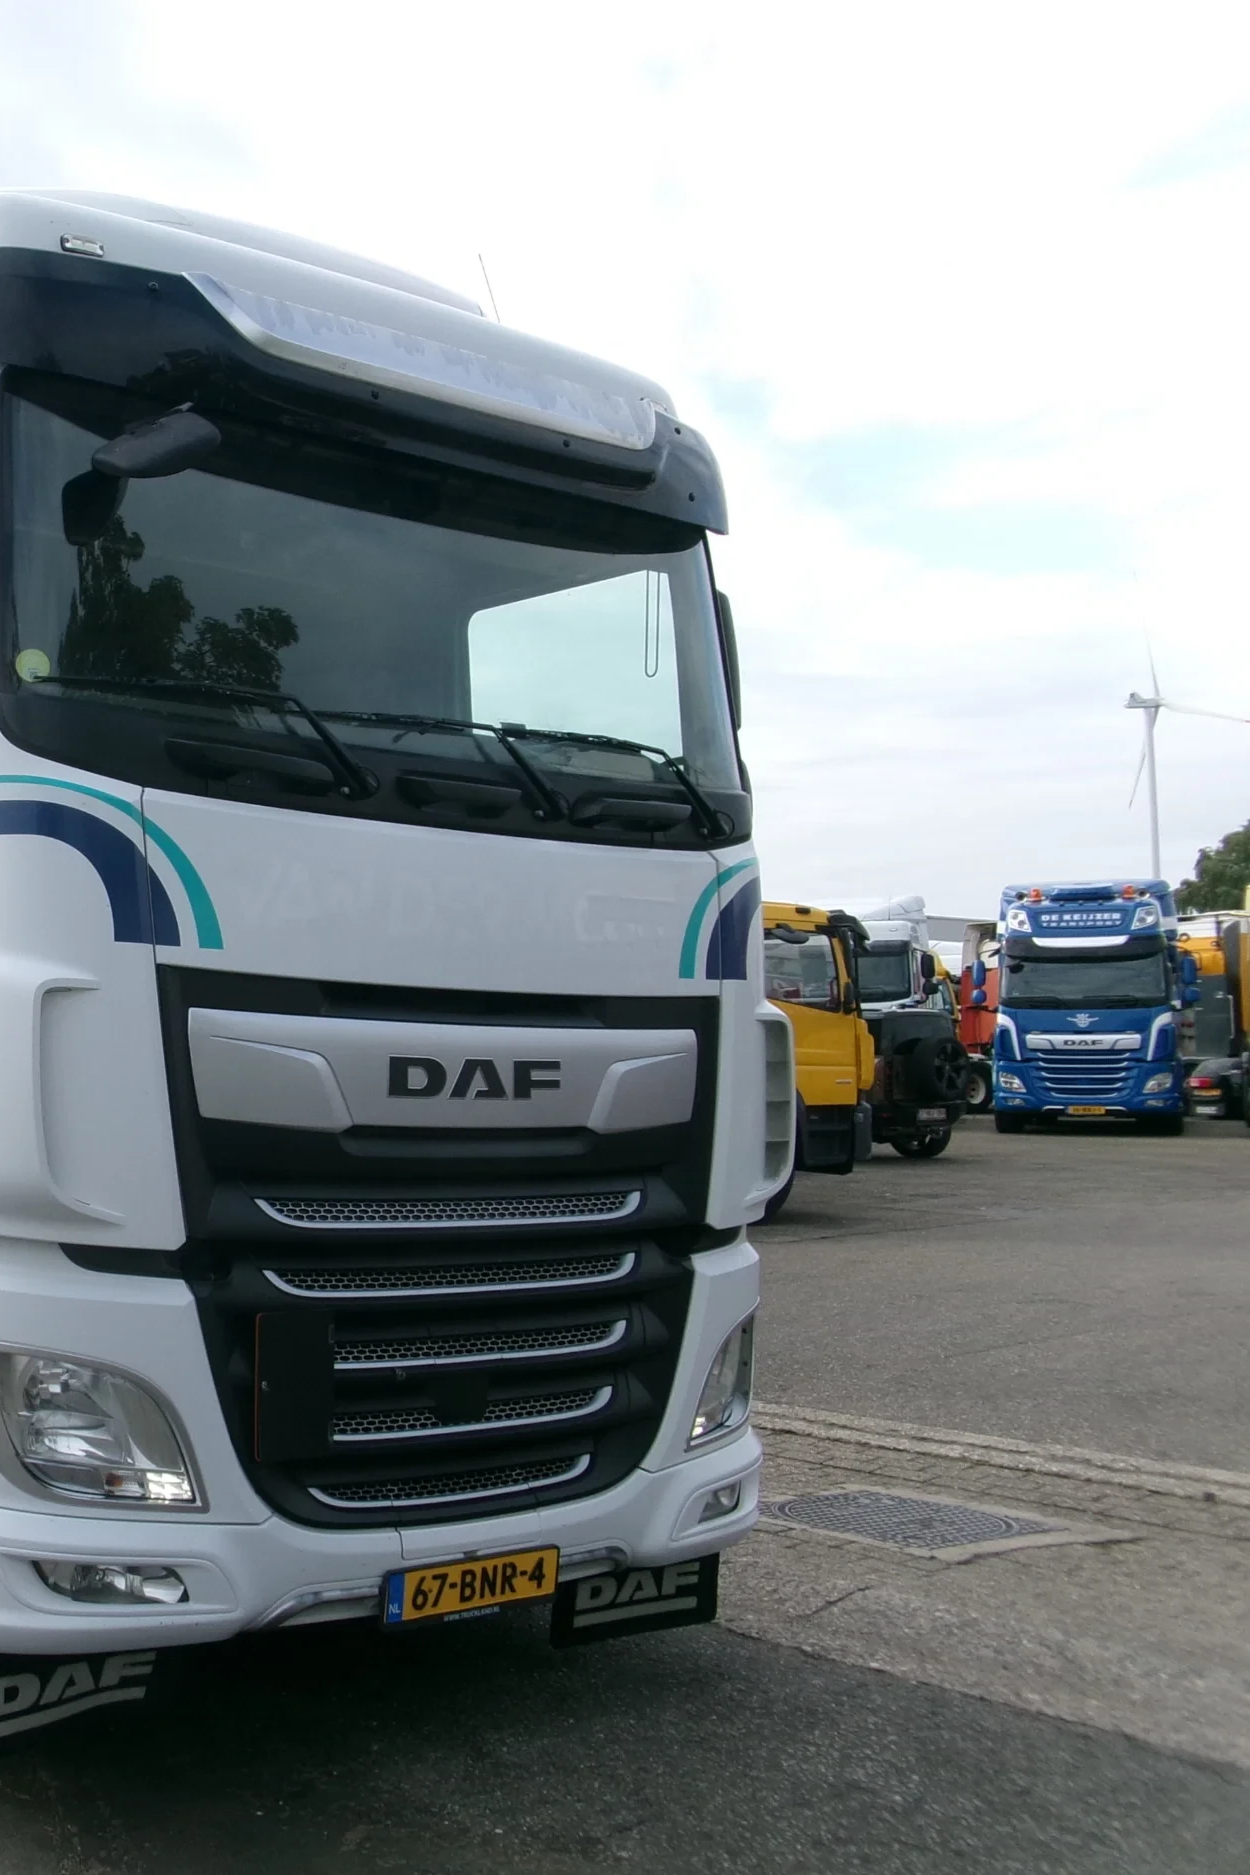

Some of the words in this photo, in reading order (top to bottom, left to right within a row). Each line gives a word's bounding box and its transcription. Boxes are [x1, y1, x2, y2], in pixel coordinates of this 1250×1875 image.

[1063, 1039, 1104, 1047] DAF
[387, 1054, 562, 1101] DAF
[411, 1556, 546, 1611] 67-BNR-4
[575, 1561, 701, 1612] DAF
[388, 1602, 402, 1615] NL
